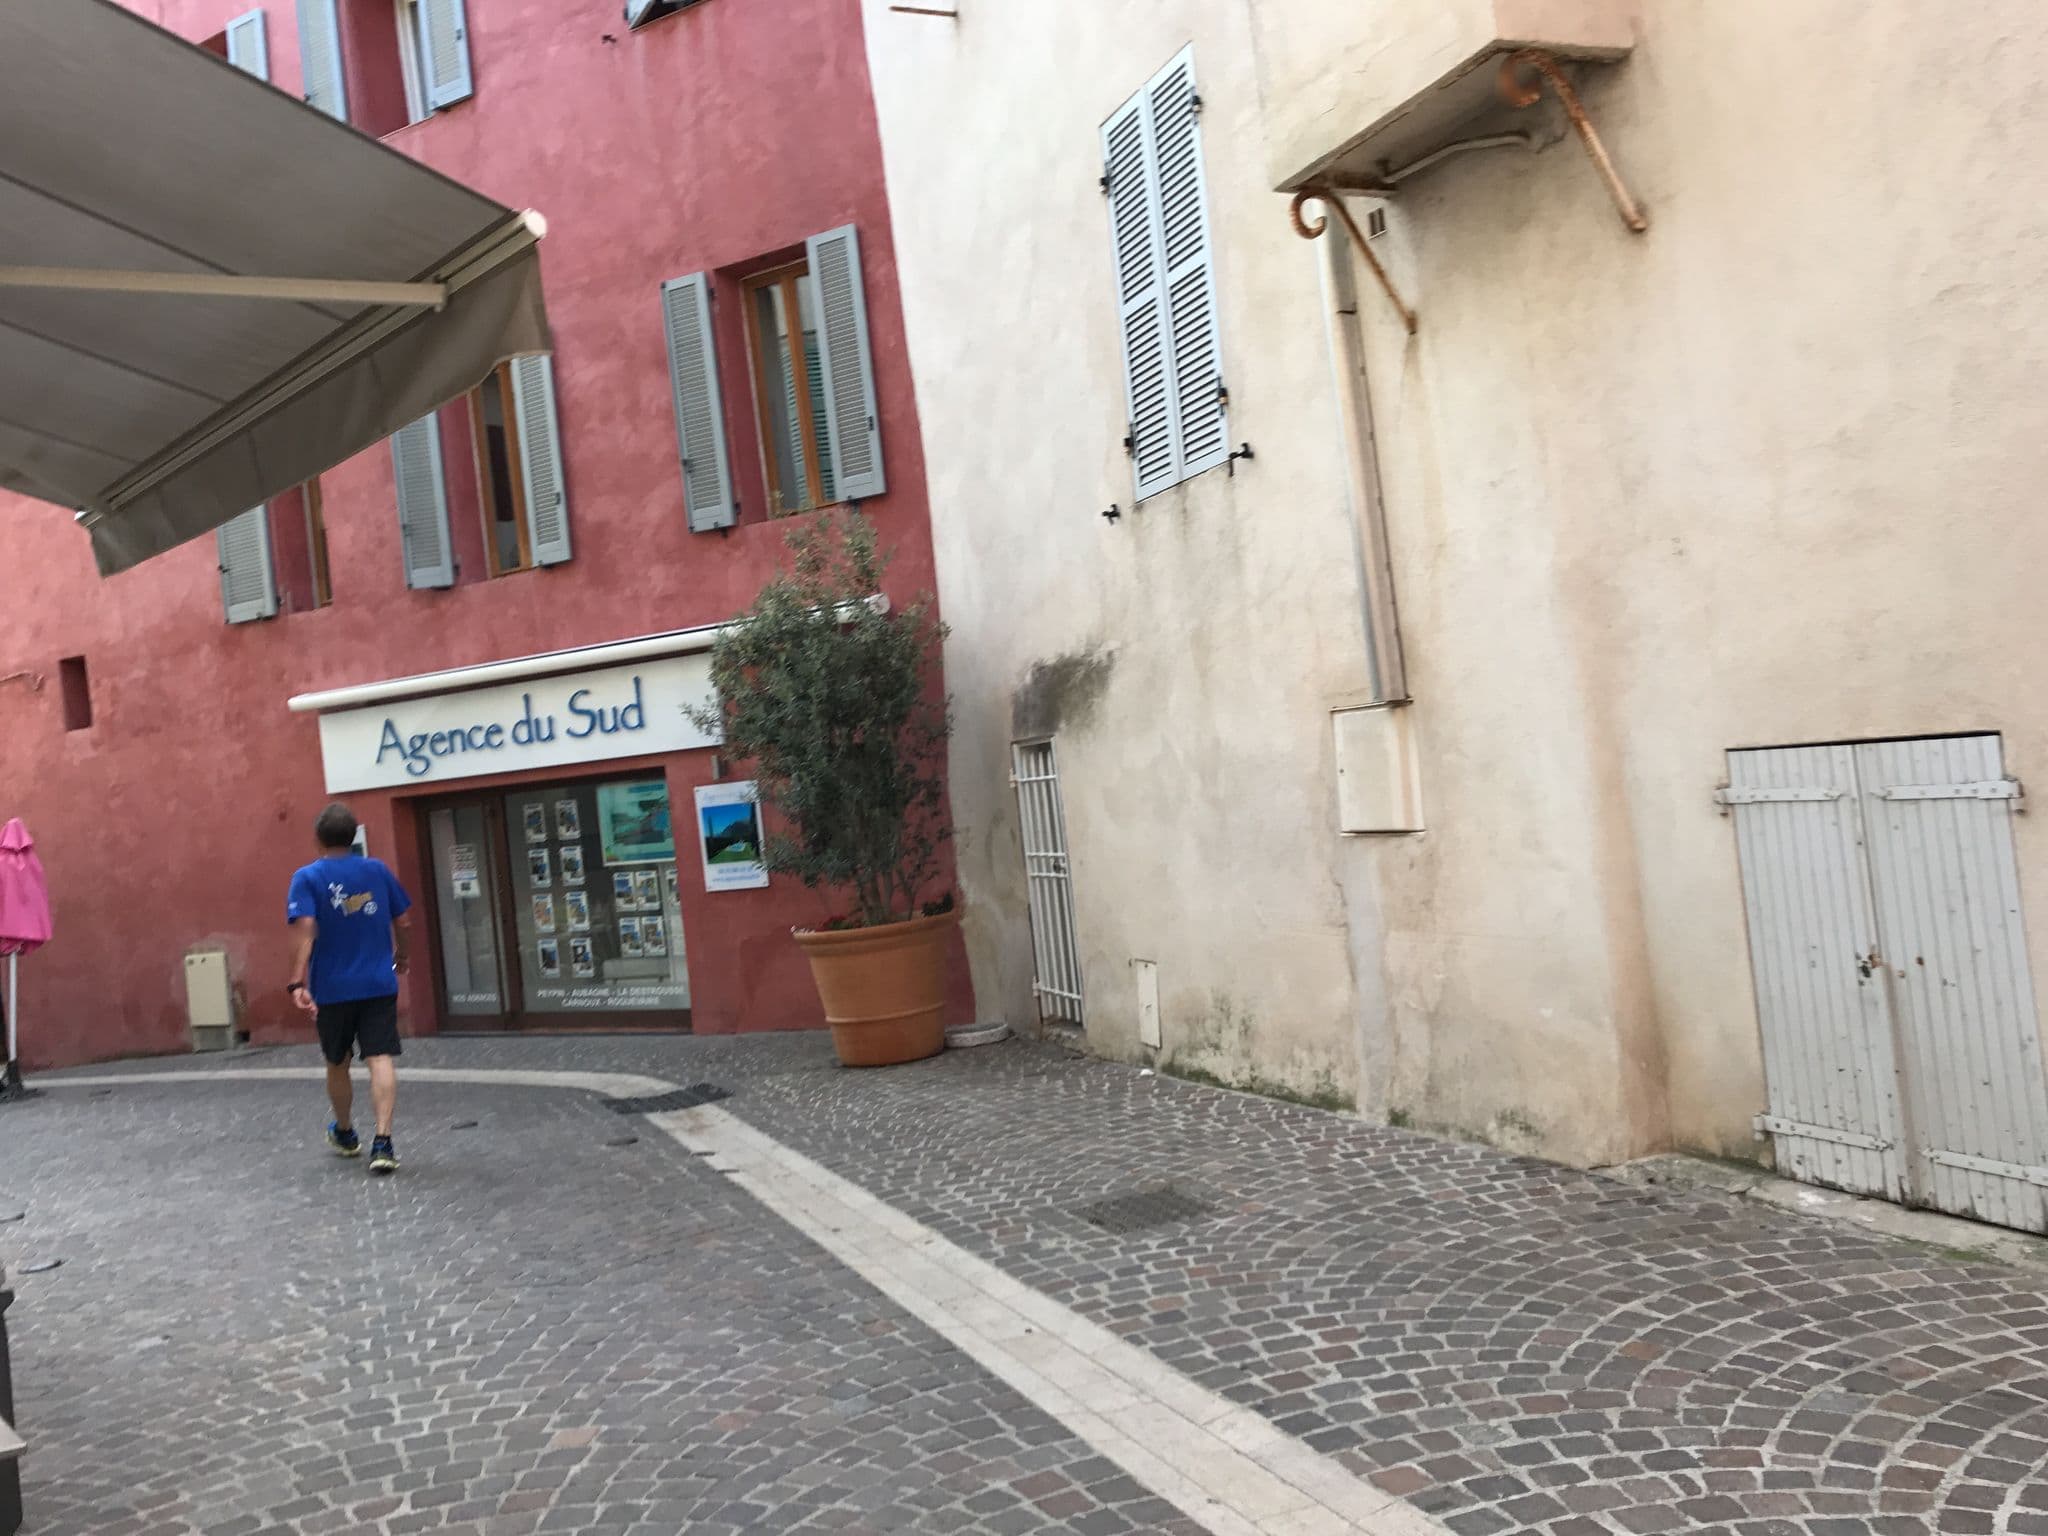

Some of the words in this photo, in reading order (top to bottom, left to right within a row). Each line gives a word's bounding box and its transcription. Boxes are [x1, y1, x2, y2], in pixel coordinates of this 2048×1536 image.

[376, 717, 503, 776] Agence
[511, 693, 555, 745] du
[566, 676, 646, 738] Sud
